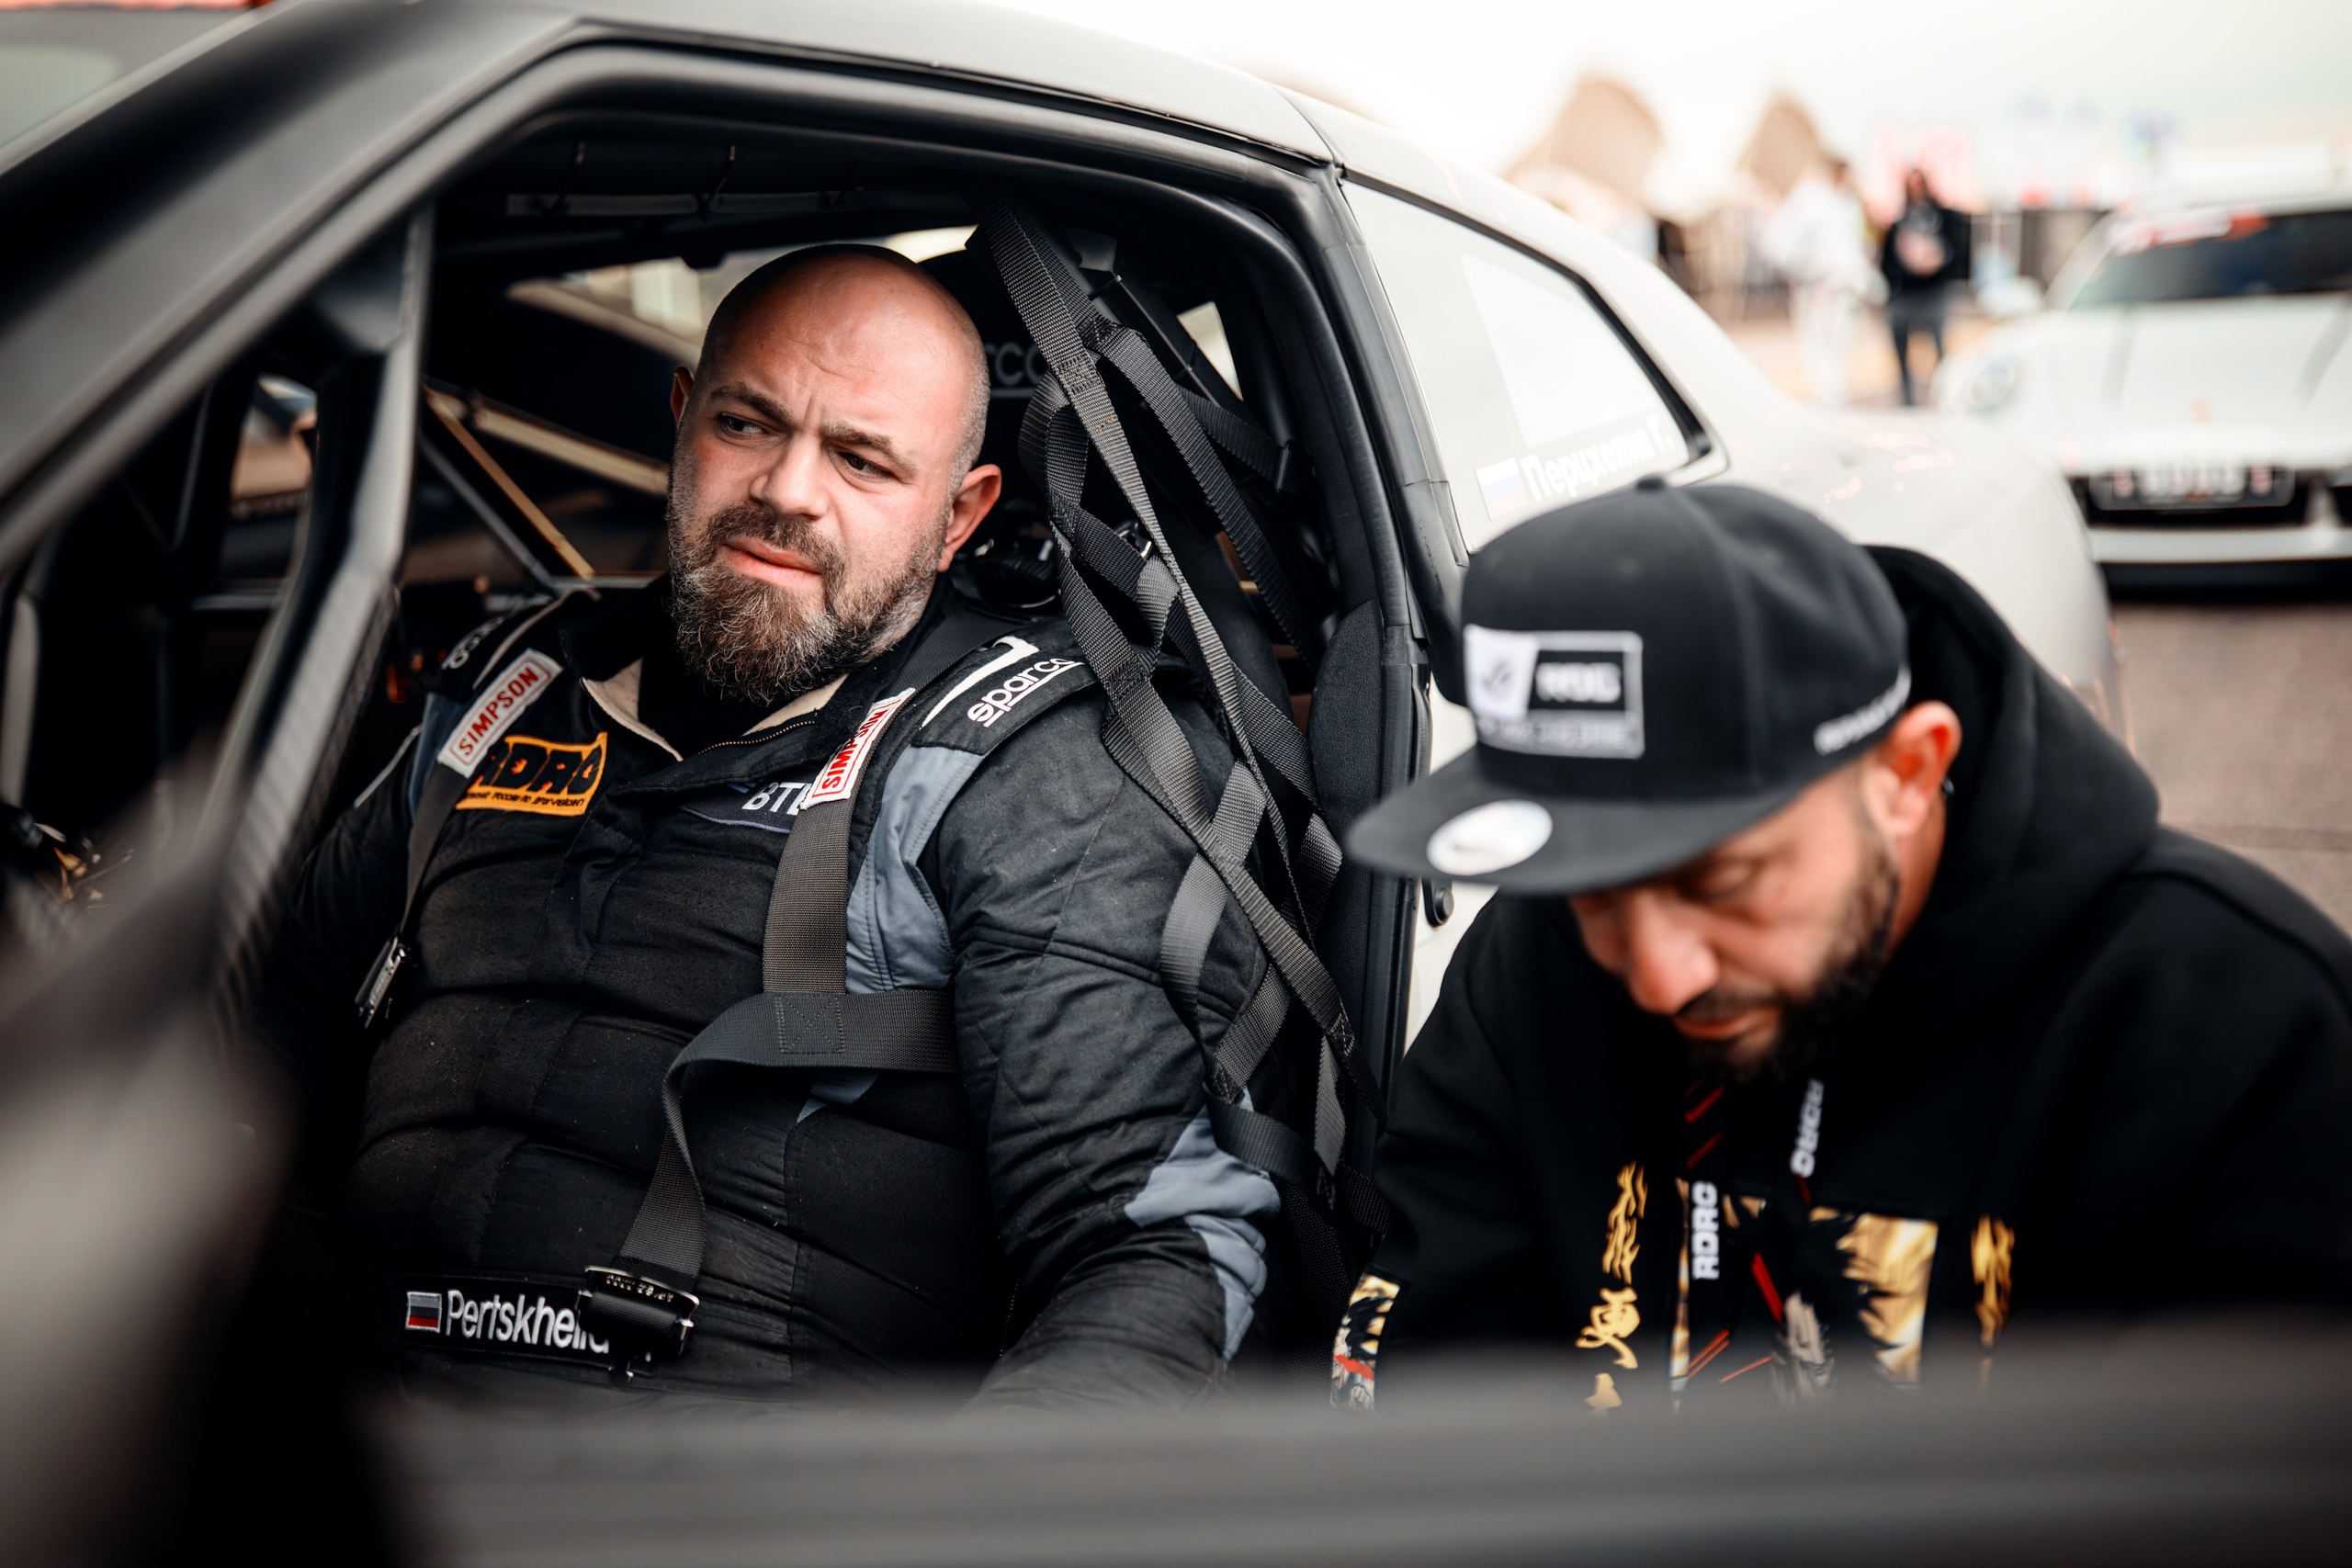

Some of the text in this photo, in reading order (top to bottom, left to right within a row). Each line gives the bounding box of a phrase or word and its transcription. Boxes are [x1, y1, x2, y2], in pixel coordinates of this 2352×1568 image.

[459, 667, 539, 756] SIMPSON
[967, 658, 1076, 724] sparco
[1691, 1180, 1720, 1280] RDRC
